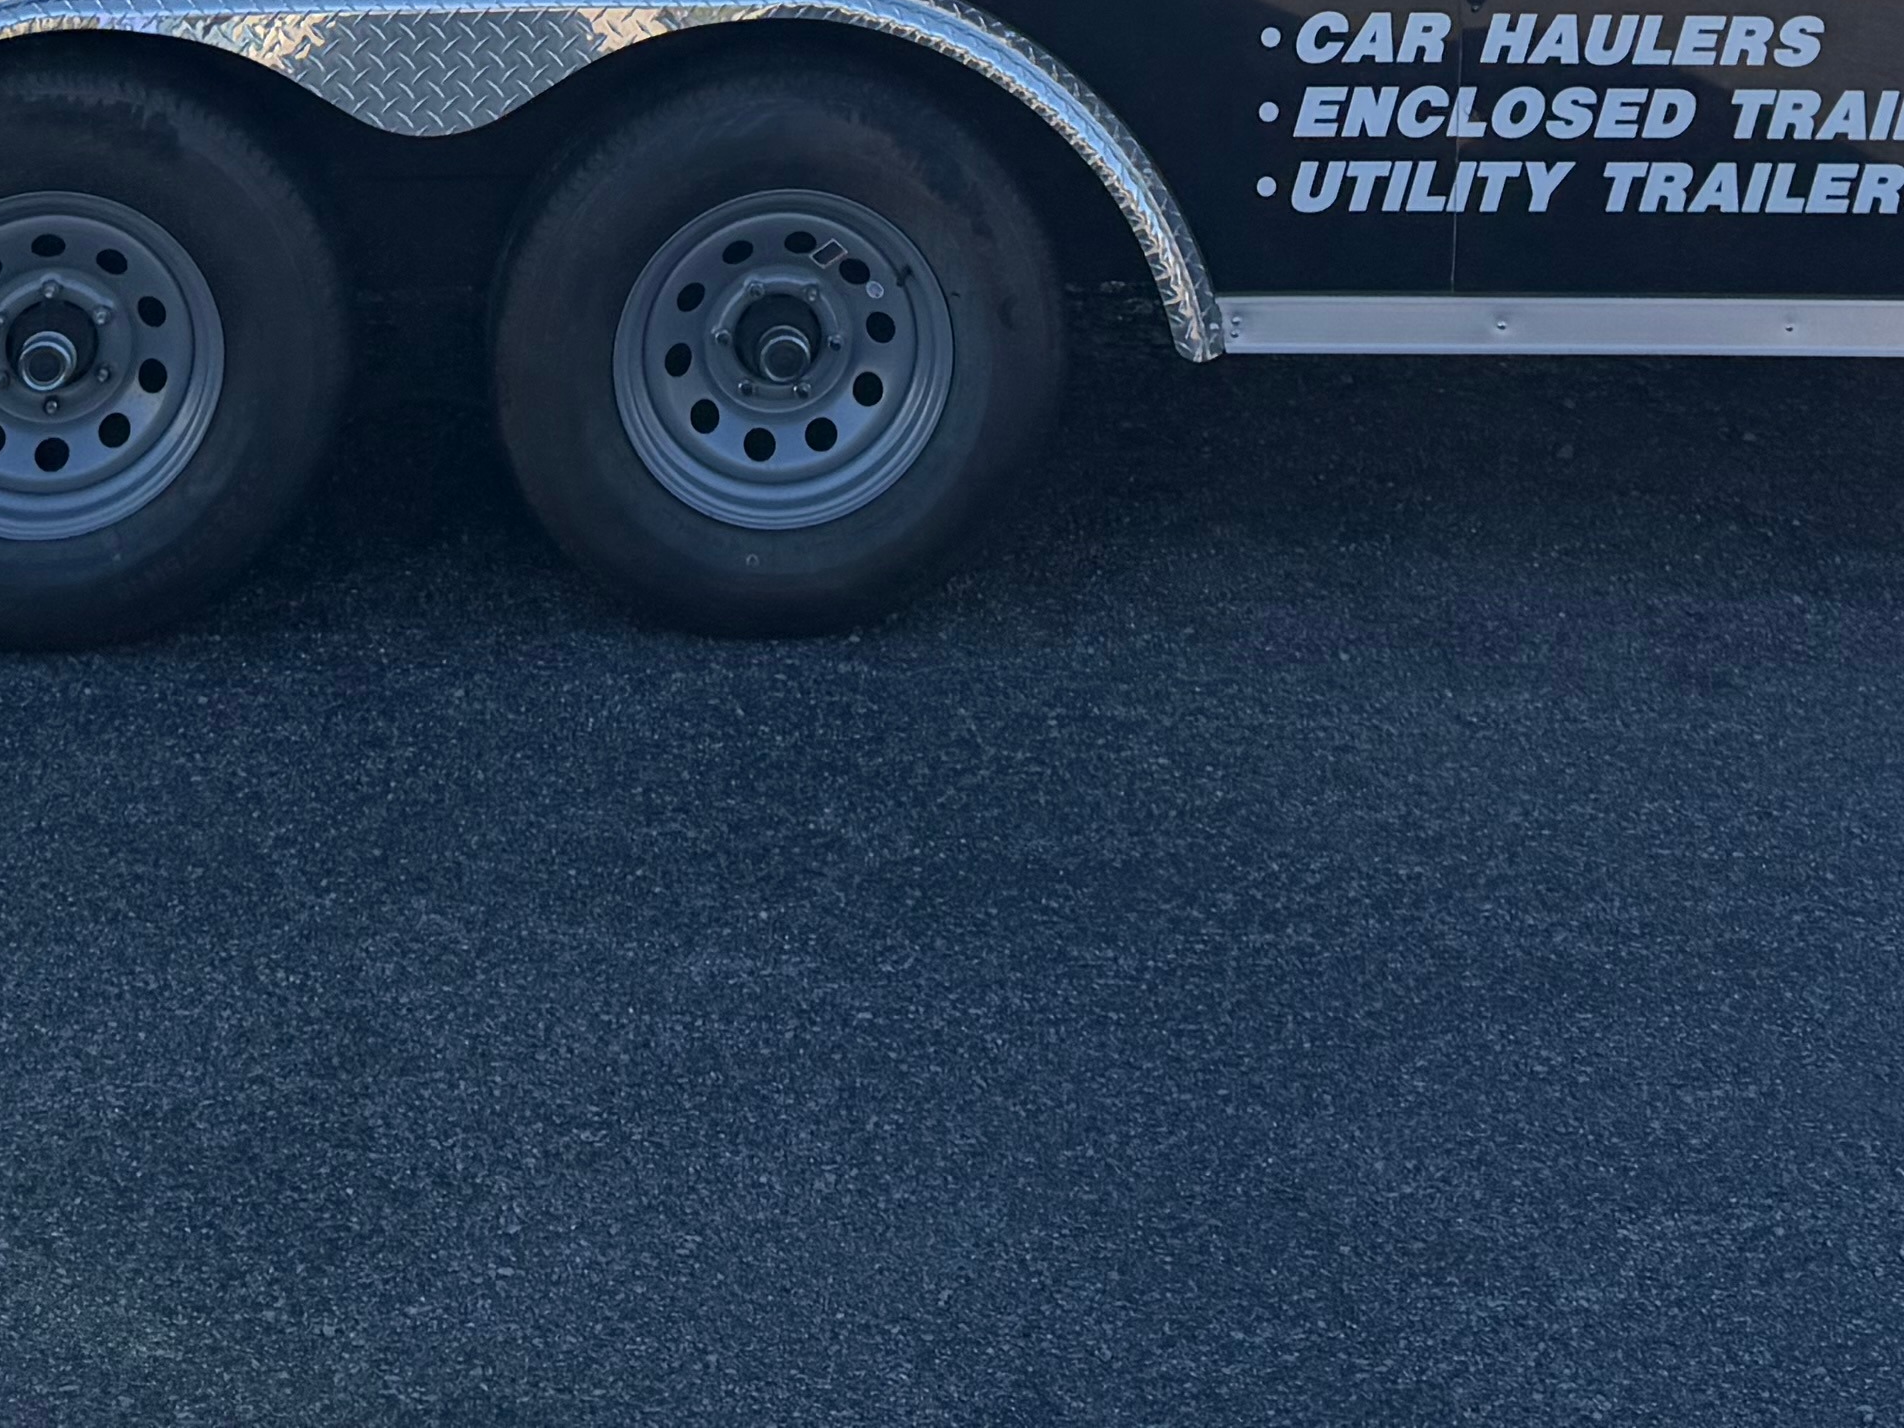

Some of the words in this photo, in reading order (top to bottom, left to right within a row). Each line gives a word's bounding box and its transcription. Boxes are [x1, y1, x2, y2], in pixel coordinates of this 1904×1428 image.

[1295, 10, 1453, 65] CAR
[1478, 12, 1826, 69] HAULERS
[1292, 84, 1698, 140] ENCLOSED
[1290, 159, 1577, 214] UTILITY
